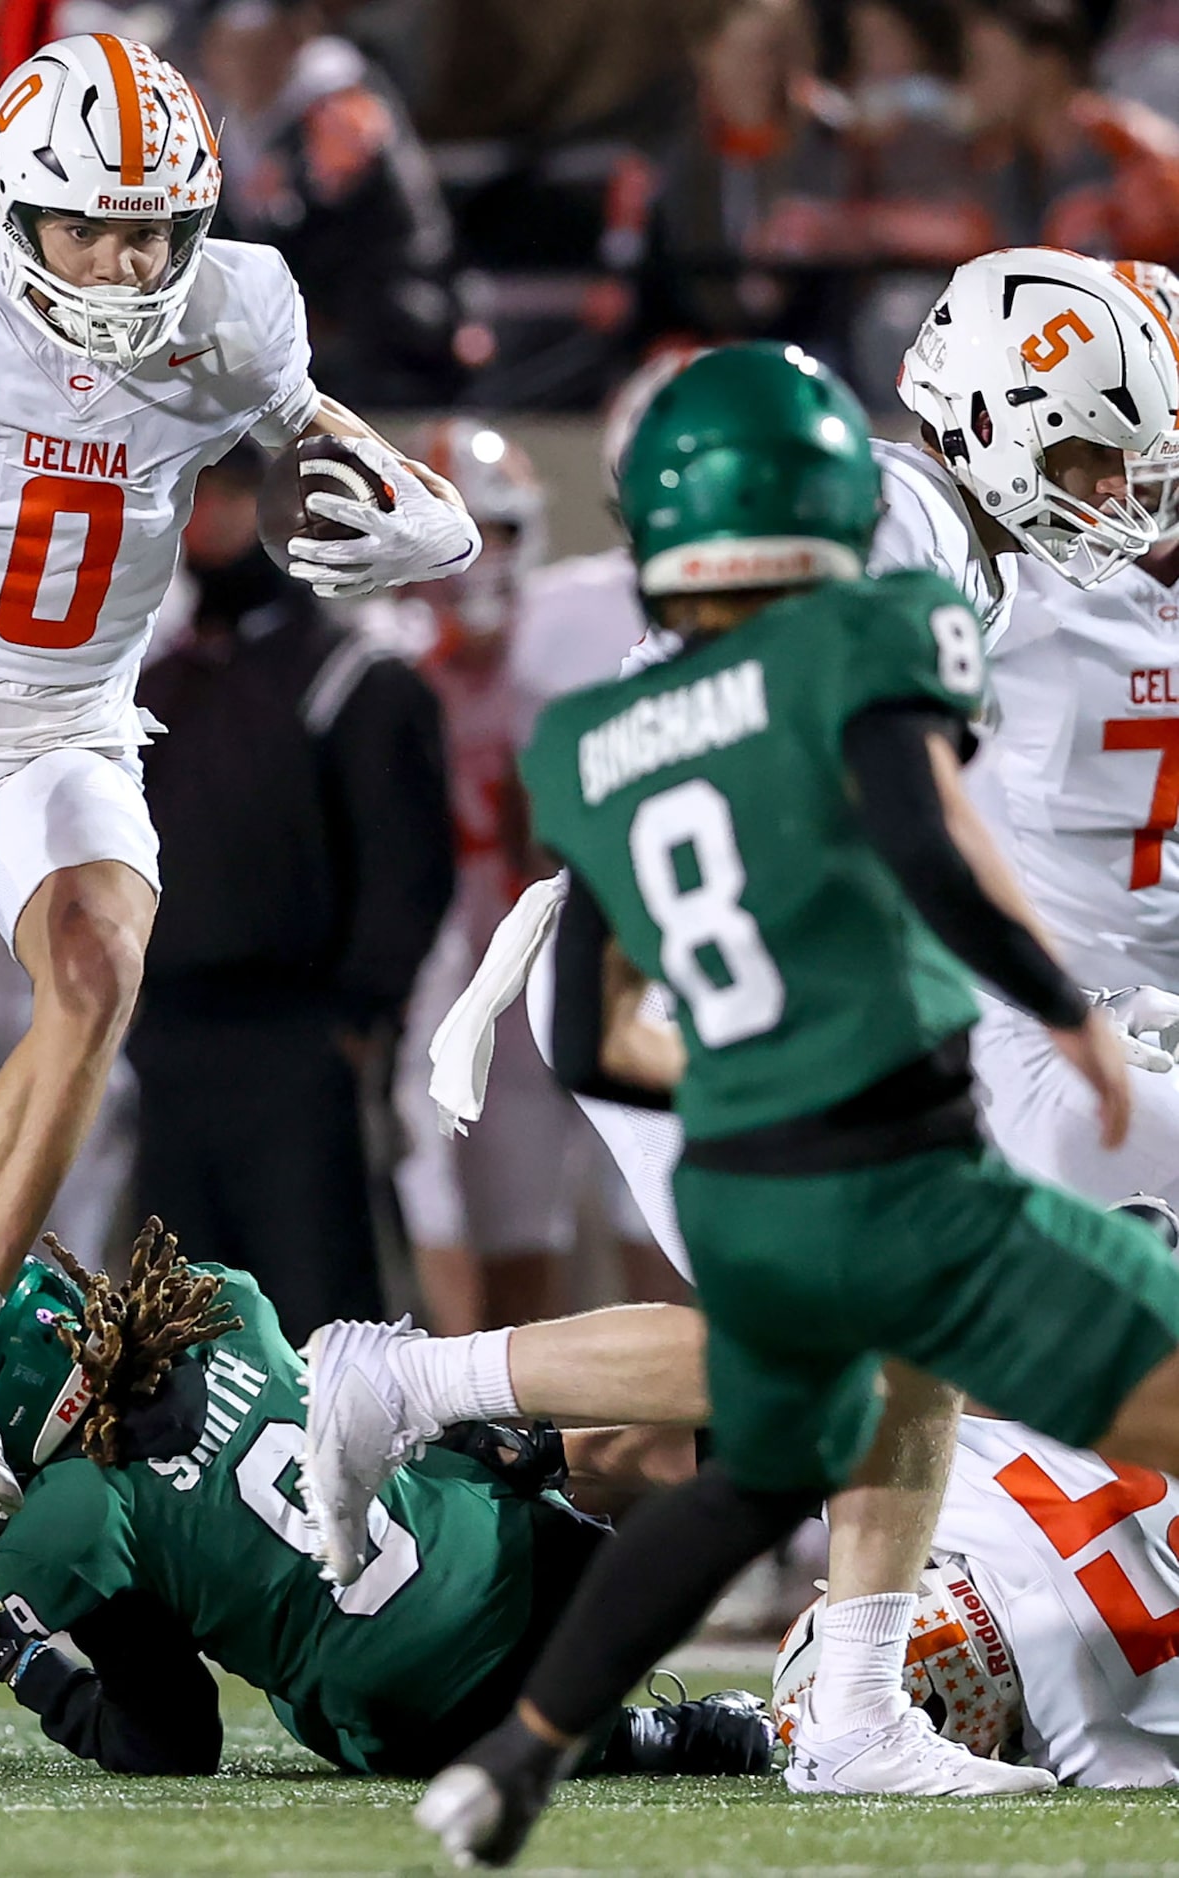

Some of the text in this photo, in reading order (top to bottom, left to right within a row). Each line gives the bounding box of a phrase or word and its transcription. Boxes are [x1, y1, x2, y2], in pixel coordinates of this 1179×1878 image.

[97, 195, 165, 212] Riddell
[1021, 308, 1094, 372] 5
[69, 375, 95, 391] C
[23, 431, 129, 479] CELINA
[930, 604, 985, 695] 8
[578, 659, 770, 806] BINGHAM
[628, 777, 786, 1048] 8
[4, 1594, 51, 1637] 9
[947, 1578, 1011, 1678] Riddell
